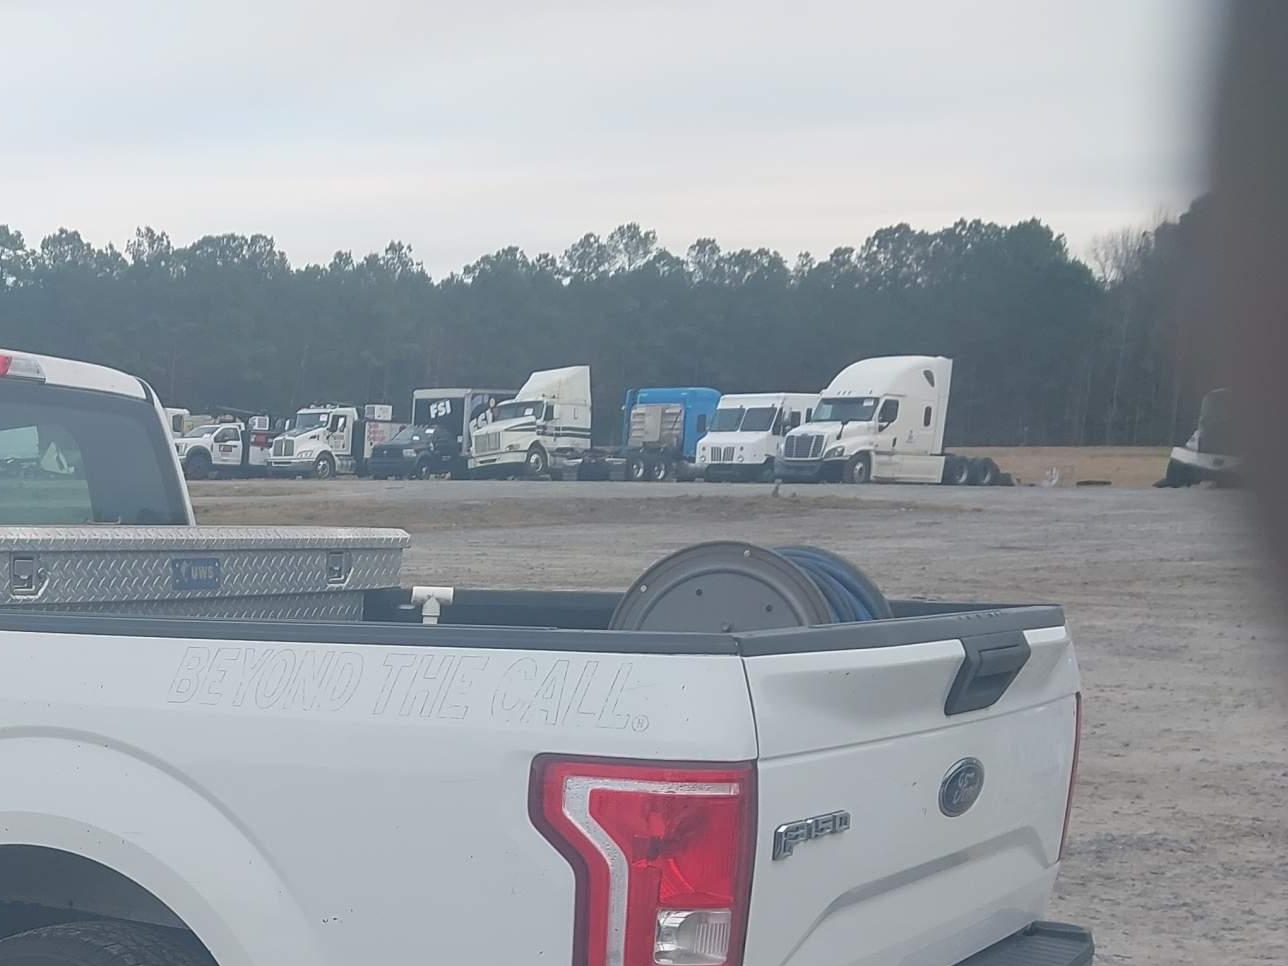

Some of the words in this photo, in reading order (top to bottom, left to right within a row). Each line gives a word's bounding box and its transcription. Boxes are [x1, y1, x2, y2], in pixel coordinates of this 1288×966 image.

[430, 399, 451, 419] FSI
[167, 646, 366, 711] BEYOND
[368, 653, 490, 721] THE
